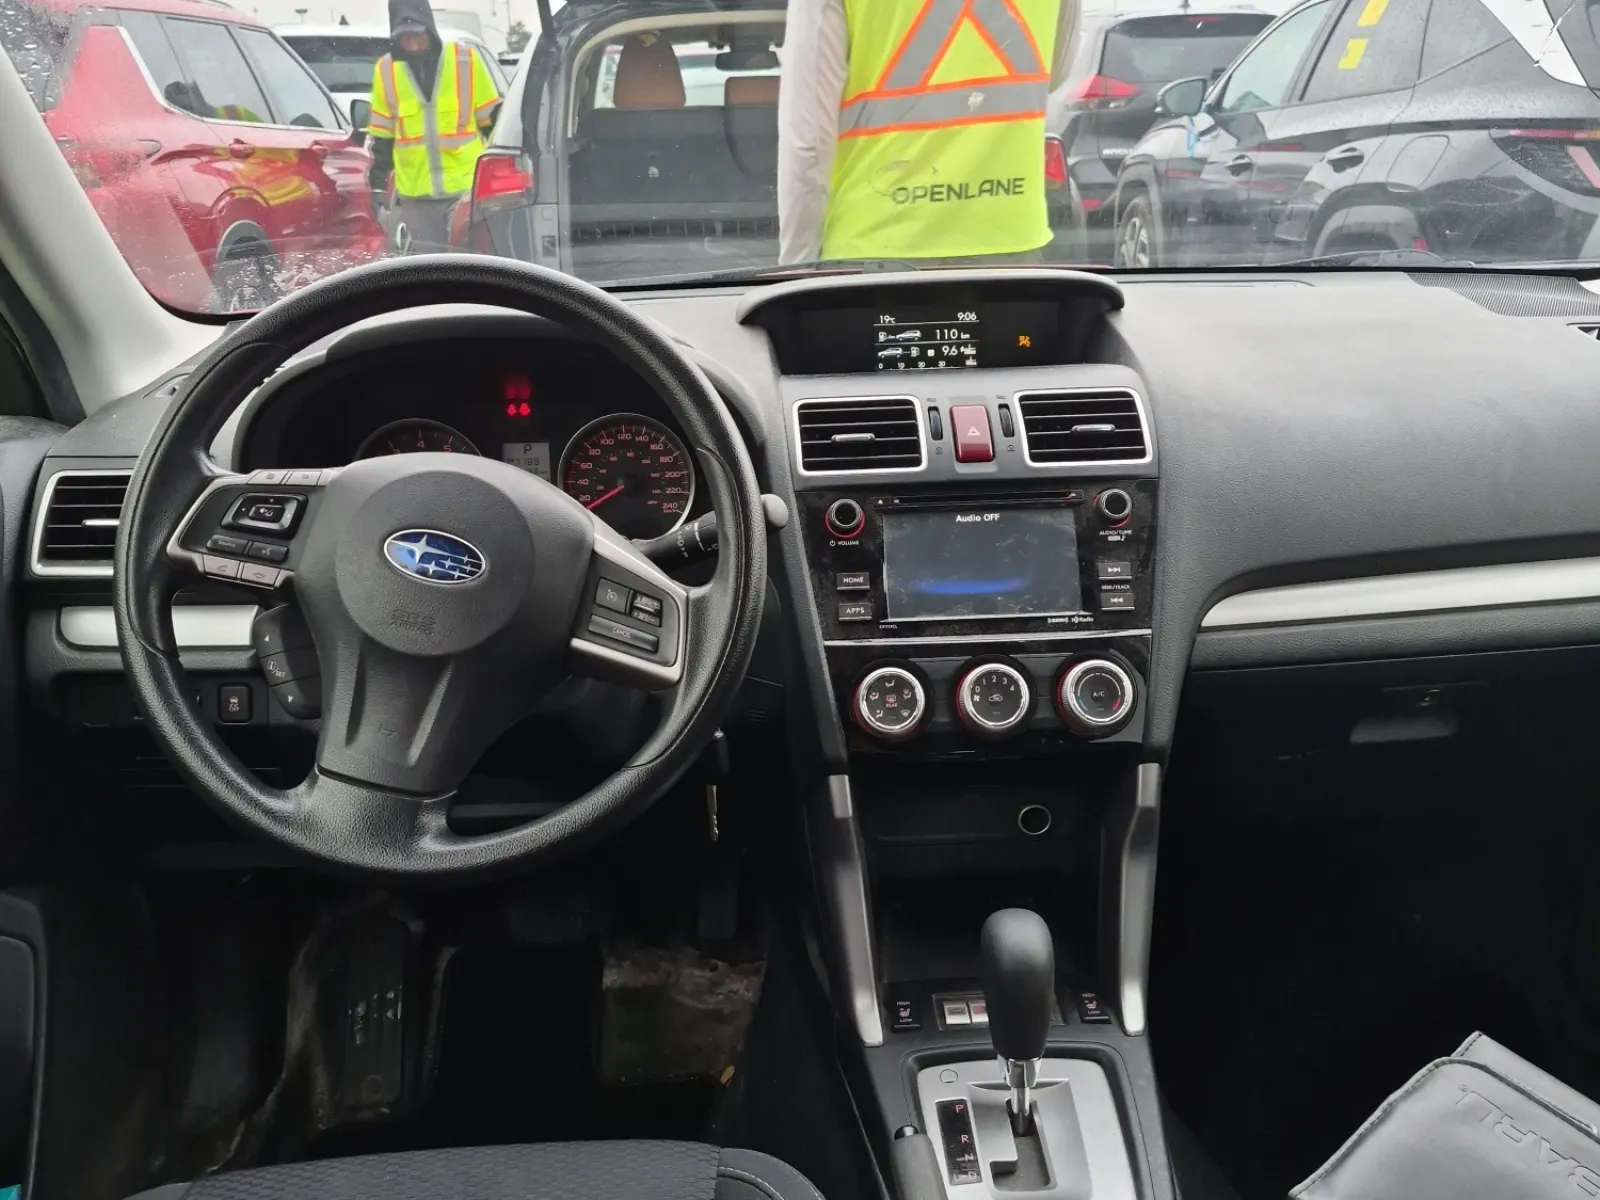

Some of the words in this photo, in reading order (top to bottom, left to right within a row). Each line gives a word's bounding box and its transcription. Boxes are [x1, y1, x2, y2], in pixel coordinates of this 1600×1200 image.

[891, 177, 1025, 205] OPENLANE
[957, 312, 977, 321] 9:06
[936, 329, 958, 340] 110
[942, 345, 958, 356] 9.6
[417, 440, 425, 448] 4
[524, 444, 532, 455] P
[956, 514, 981, 523] Audio
[983, 513, 1000, 522] OFF
[843, 576, 864, 584] HOME
[846, 606, 865, 614] APPS
[991, 674, 997, 683] 2
[1001, 676, 1007, 685] 3
[955, 1104, 963, 1113] P
[961, 1134, 969, 1144] R
[964, 1153, 974, 1161] N
